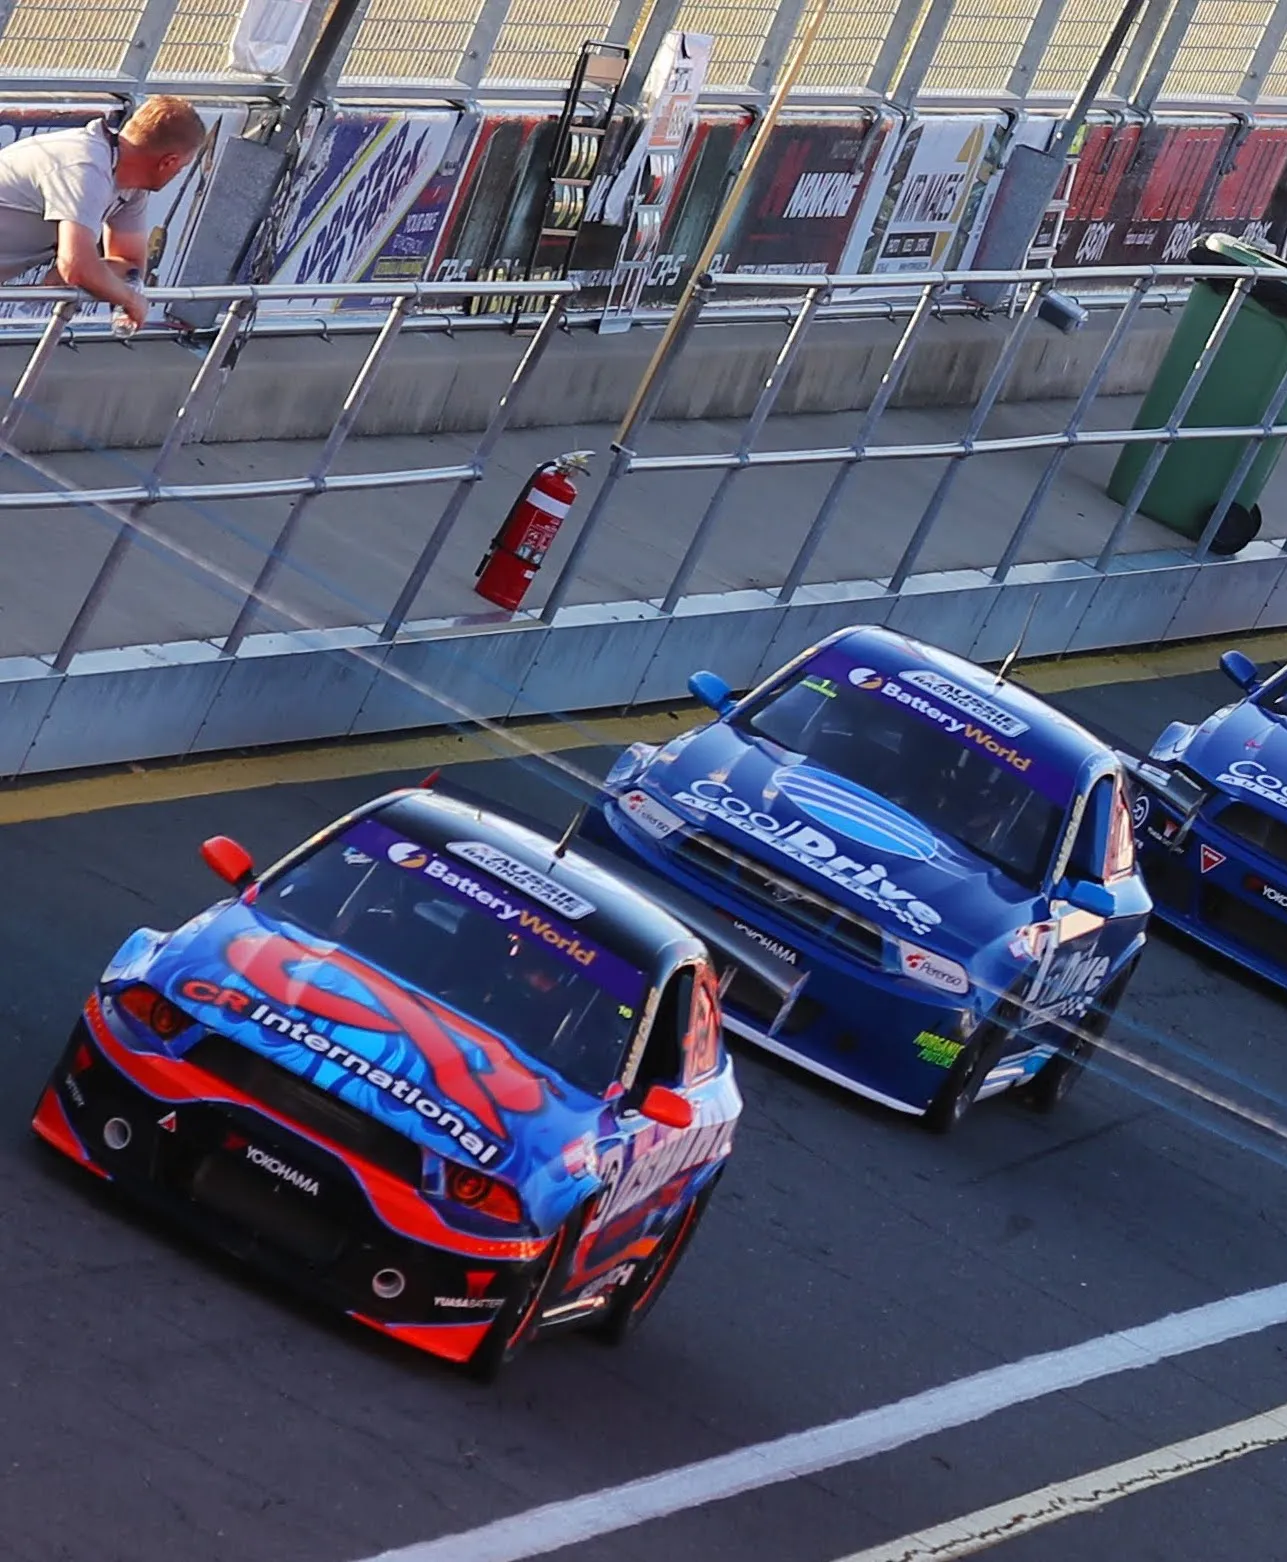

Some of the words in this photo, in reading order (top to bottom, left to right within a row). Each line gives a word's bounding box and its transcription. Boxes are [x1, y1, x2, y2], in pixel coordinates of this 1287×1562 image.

[783, 172, 864, 219] NANKANG
[939, 682, 1021, 730] AUSSIE
[490, 849, 587, 910] AUSSIE
[690, 779, 943, 926] CoolDrive
[181, 979, 249, 1012] CR
[250, 1002, 499, 1165] International
[245, 1144, 321, 1197] YOKOHAMA
